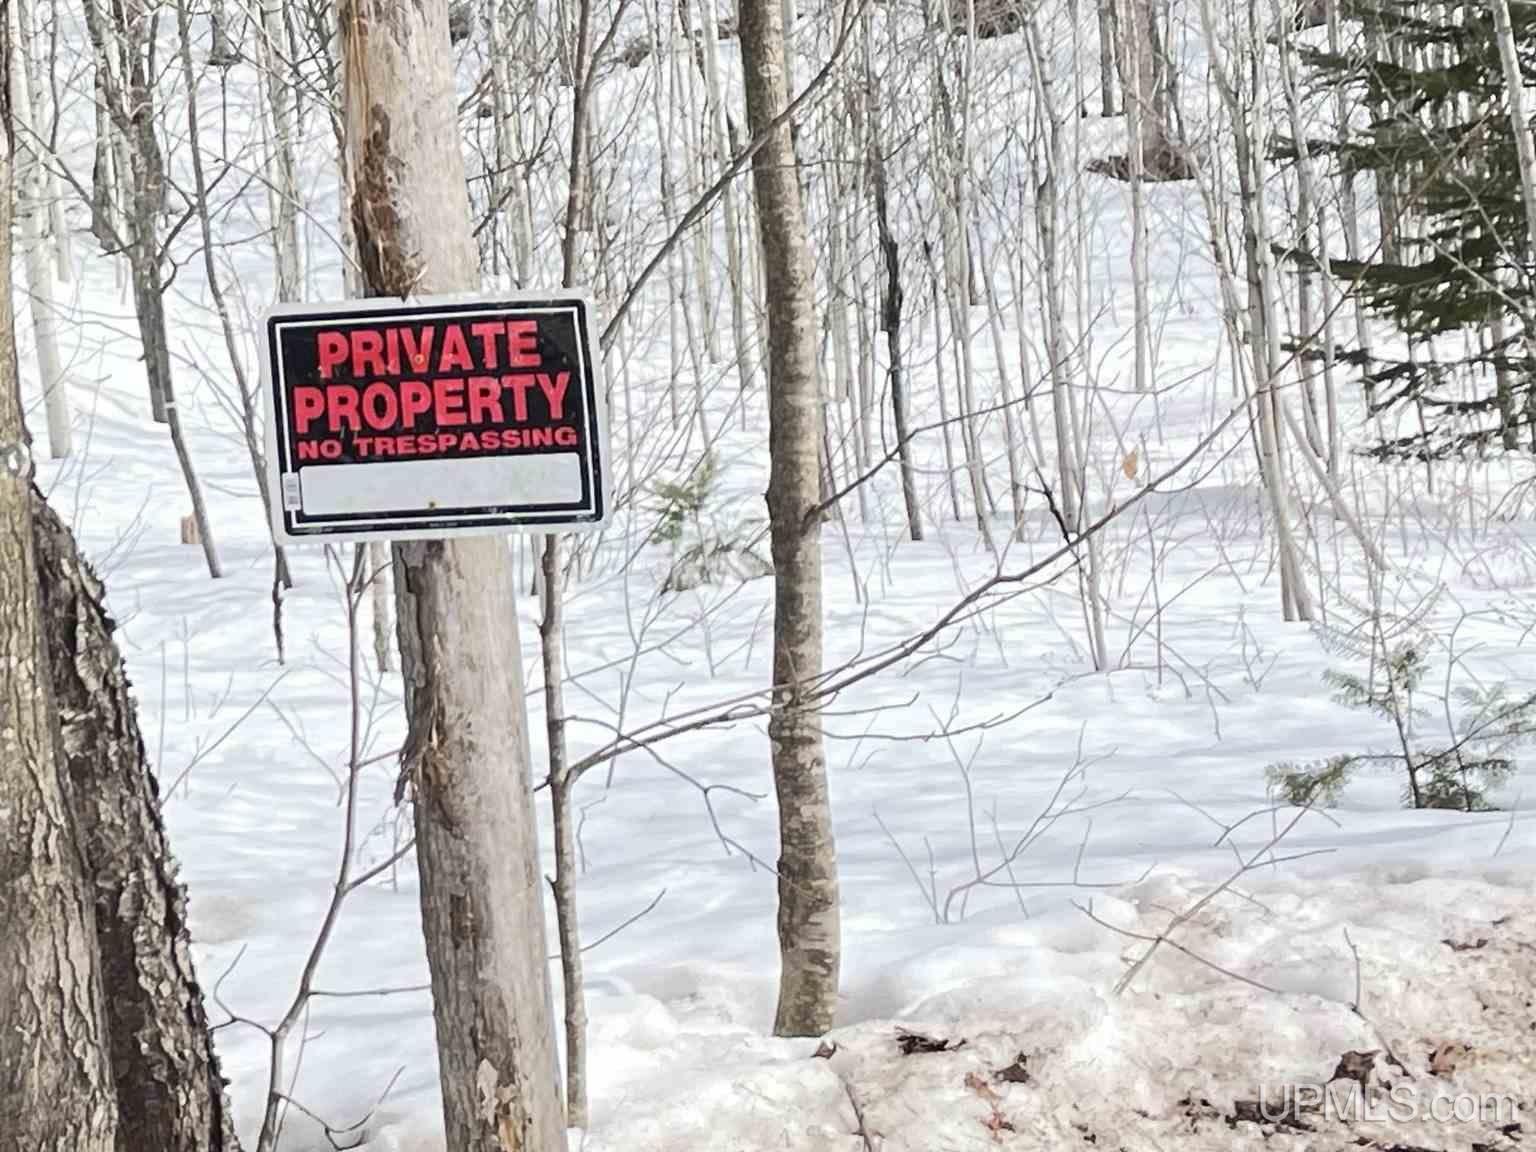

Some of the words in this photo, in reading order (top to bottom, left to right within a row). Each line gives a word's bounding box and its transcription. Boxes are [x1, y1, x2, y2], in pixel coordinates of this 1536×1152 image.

[317, 320, 542, 379] PRIVATE
[293, 371, 571, 434] PROPERTY
[298, 439, 343, 460] NO
[353, 426, 577, 457] TRESPASSING
